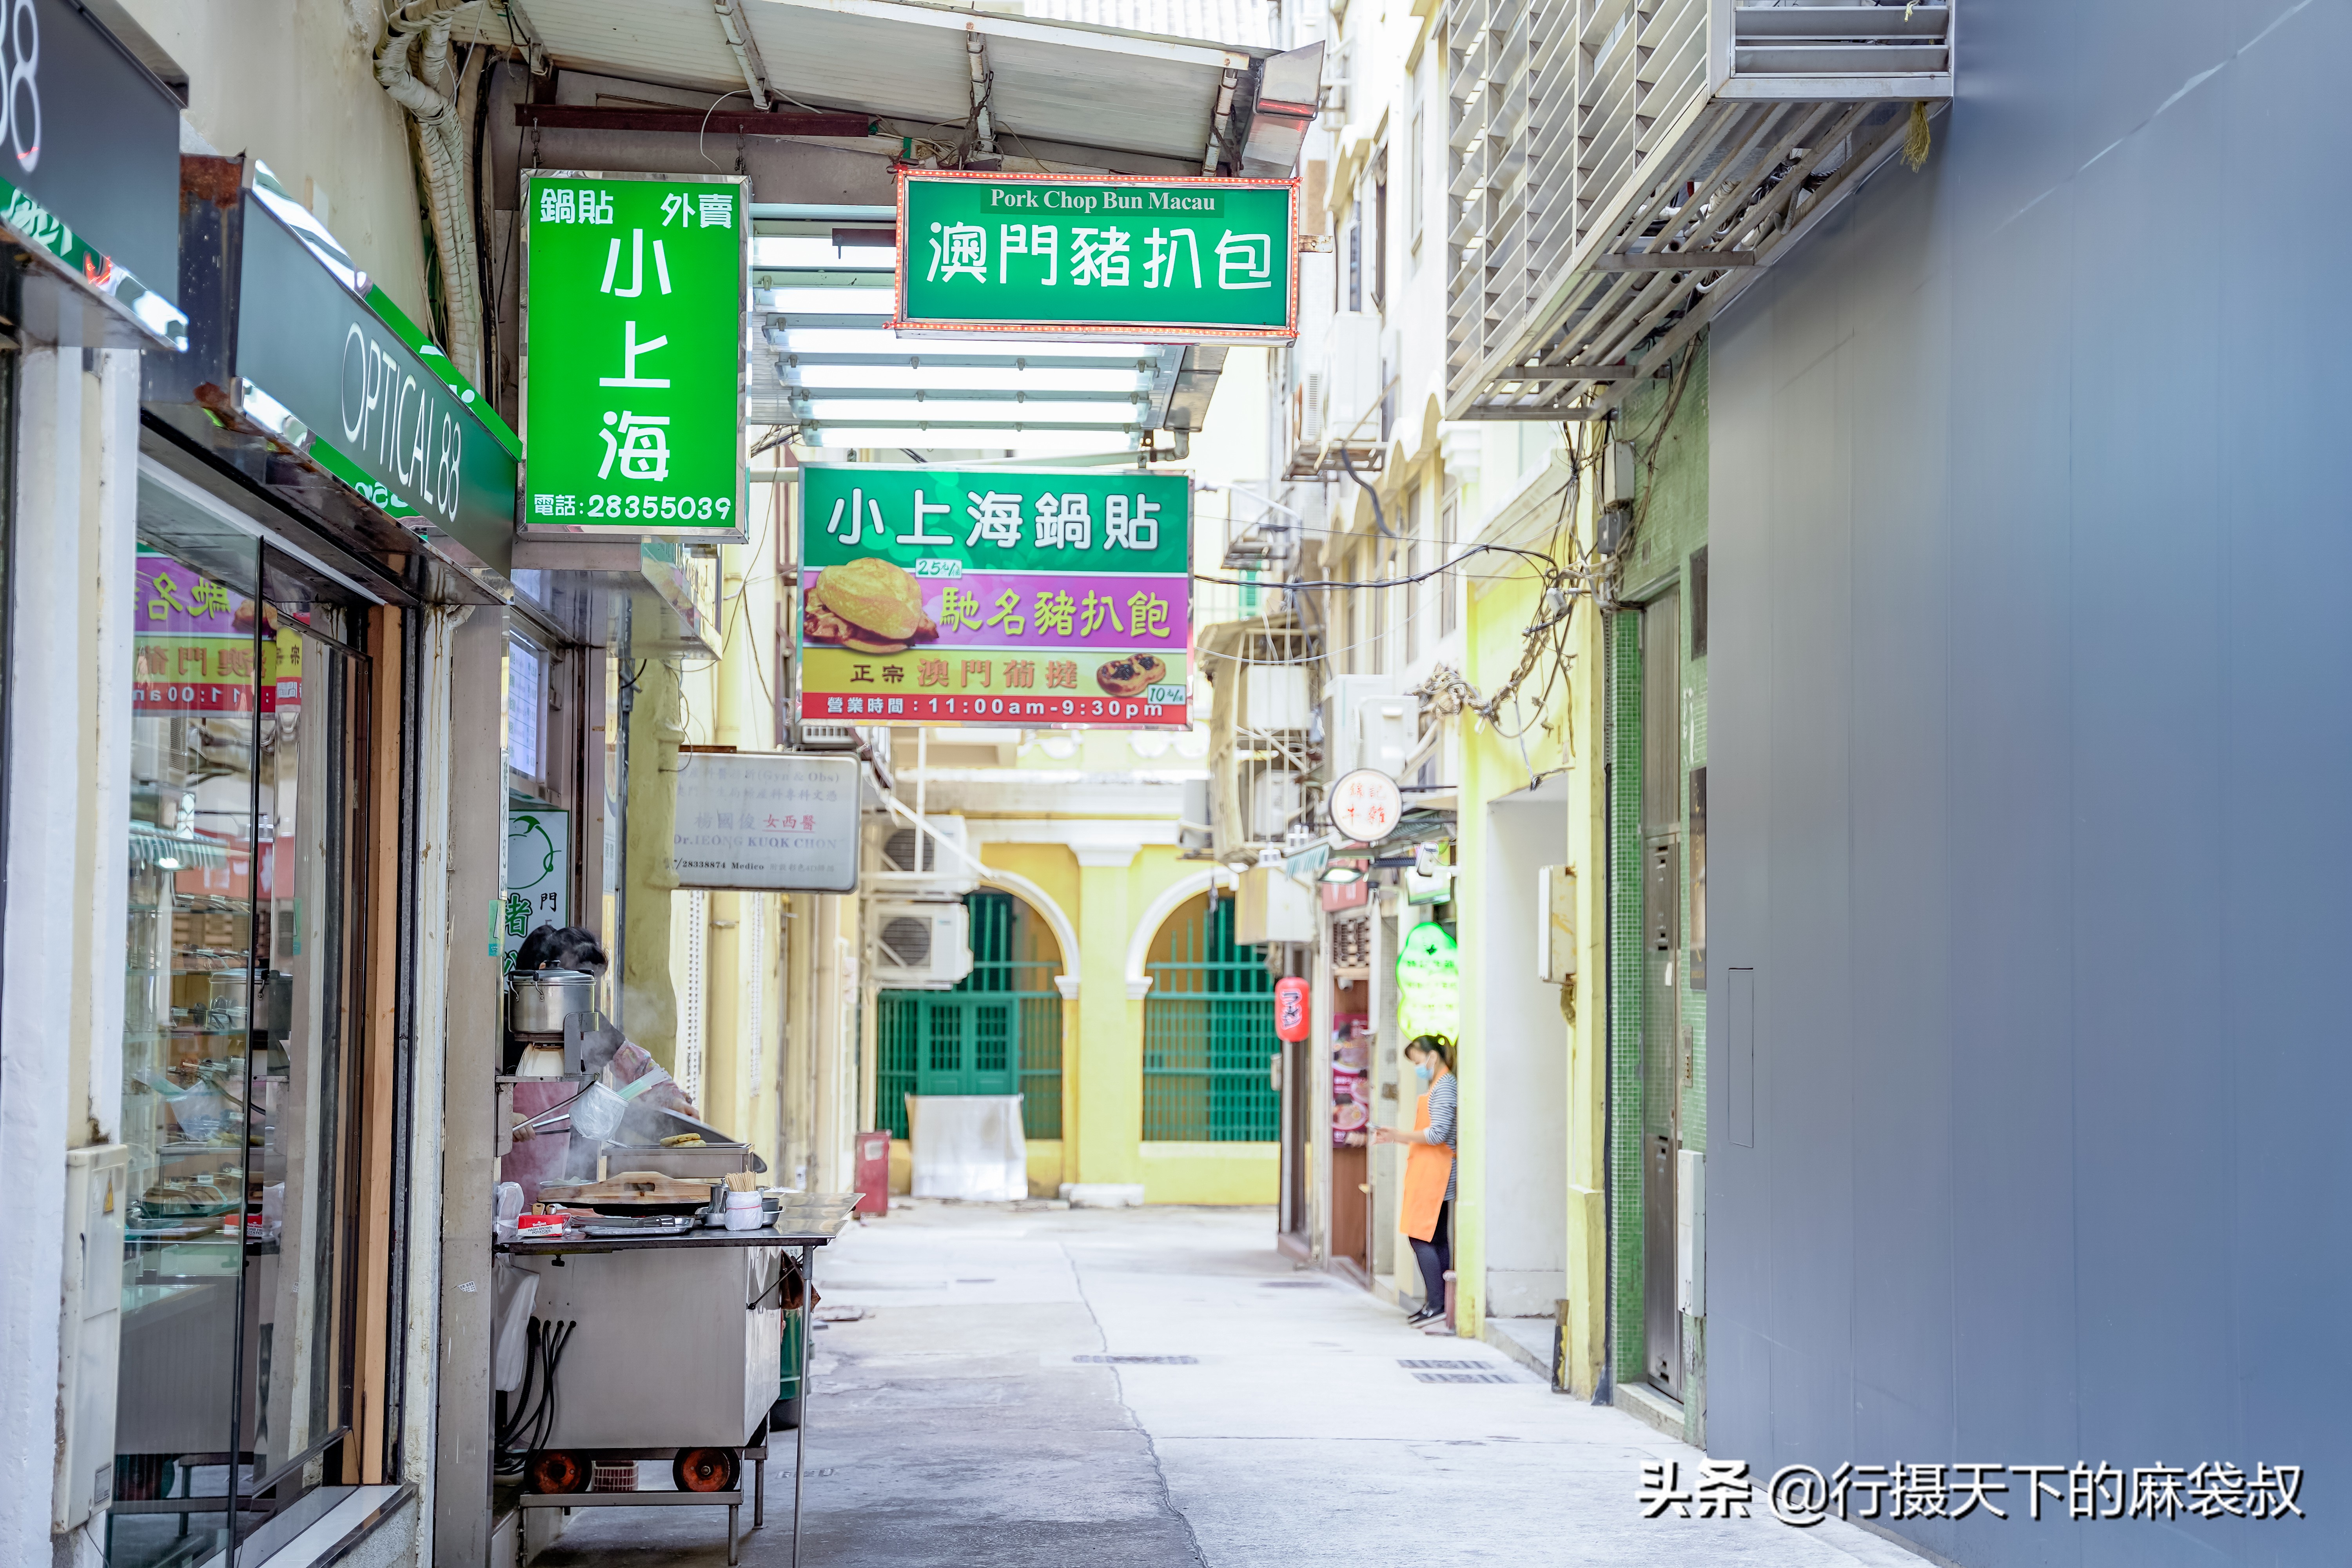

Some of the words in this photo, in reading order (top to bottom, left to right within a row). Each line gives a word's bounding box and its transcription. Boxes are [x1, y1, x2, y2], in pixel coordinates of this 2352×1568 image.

[0, 0, 40, 172] 8
[540, 188, 613, 225] 鍋貼
[660, 192, 733, 229] 外賣
[991, 188, 1039, 208] Pork
[1044, 190, 1097, 214] Chop
[1102, 191, 1143, 210] Bun
[1148, 192, 1215, 211] Macau
[926, 221, 1272, 290] 澳門豬扒包
[597, 229, 672, 482] 小上海
[342, 321, 434, 505] OPTICAL
[437, 411, 461, 523] 88
[826, 487, 1161, 550] 小上海鍋貼
[939, 586, 1171, 638] 馳名豬扒飽
[849, 664, 905, 684] 正宗
[762, 813, 816, 831] 女西醫
[731, 862, 764, 870] Medico
